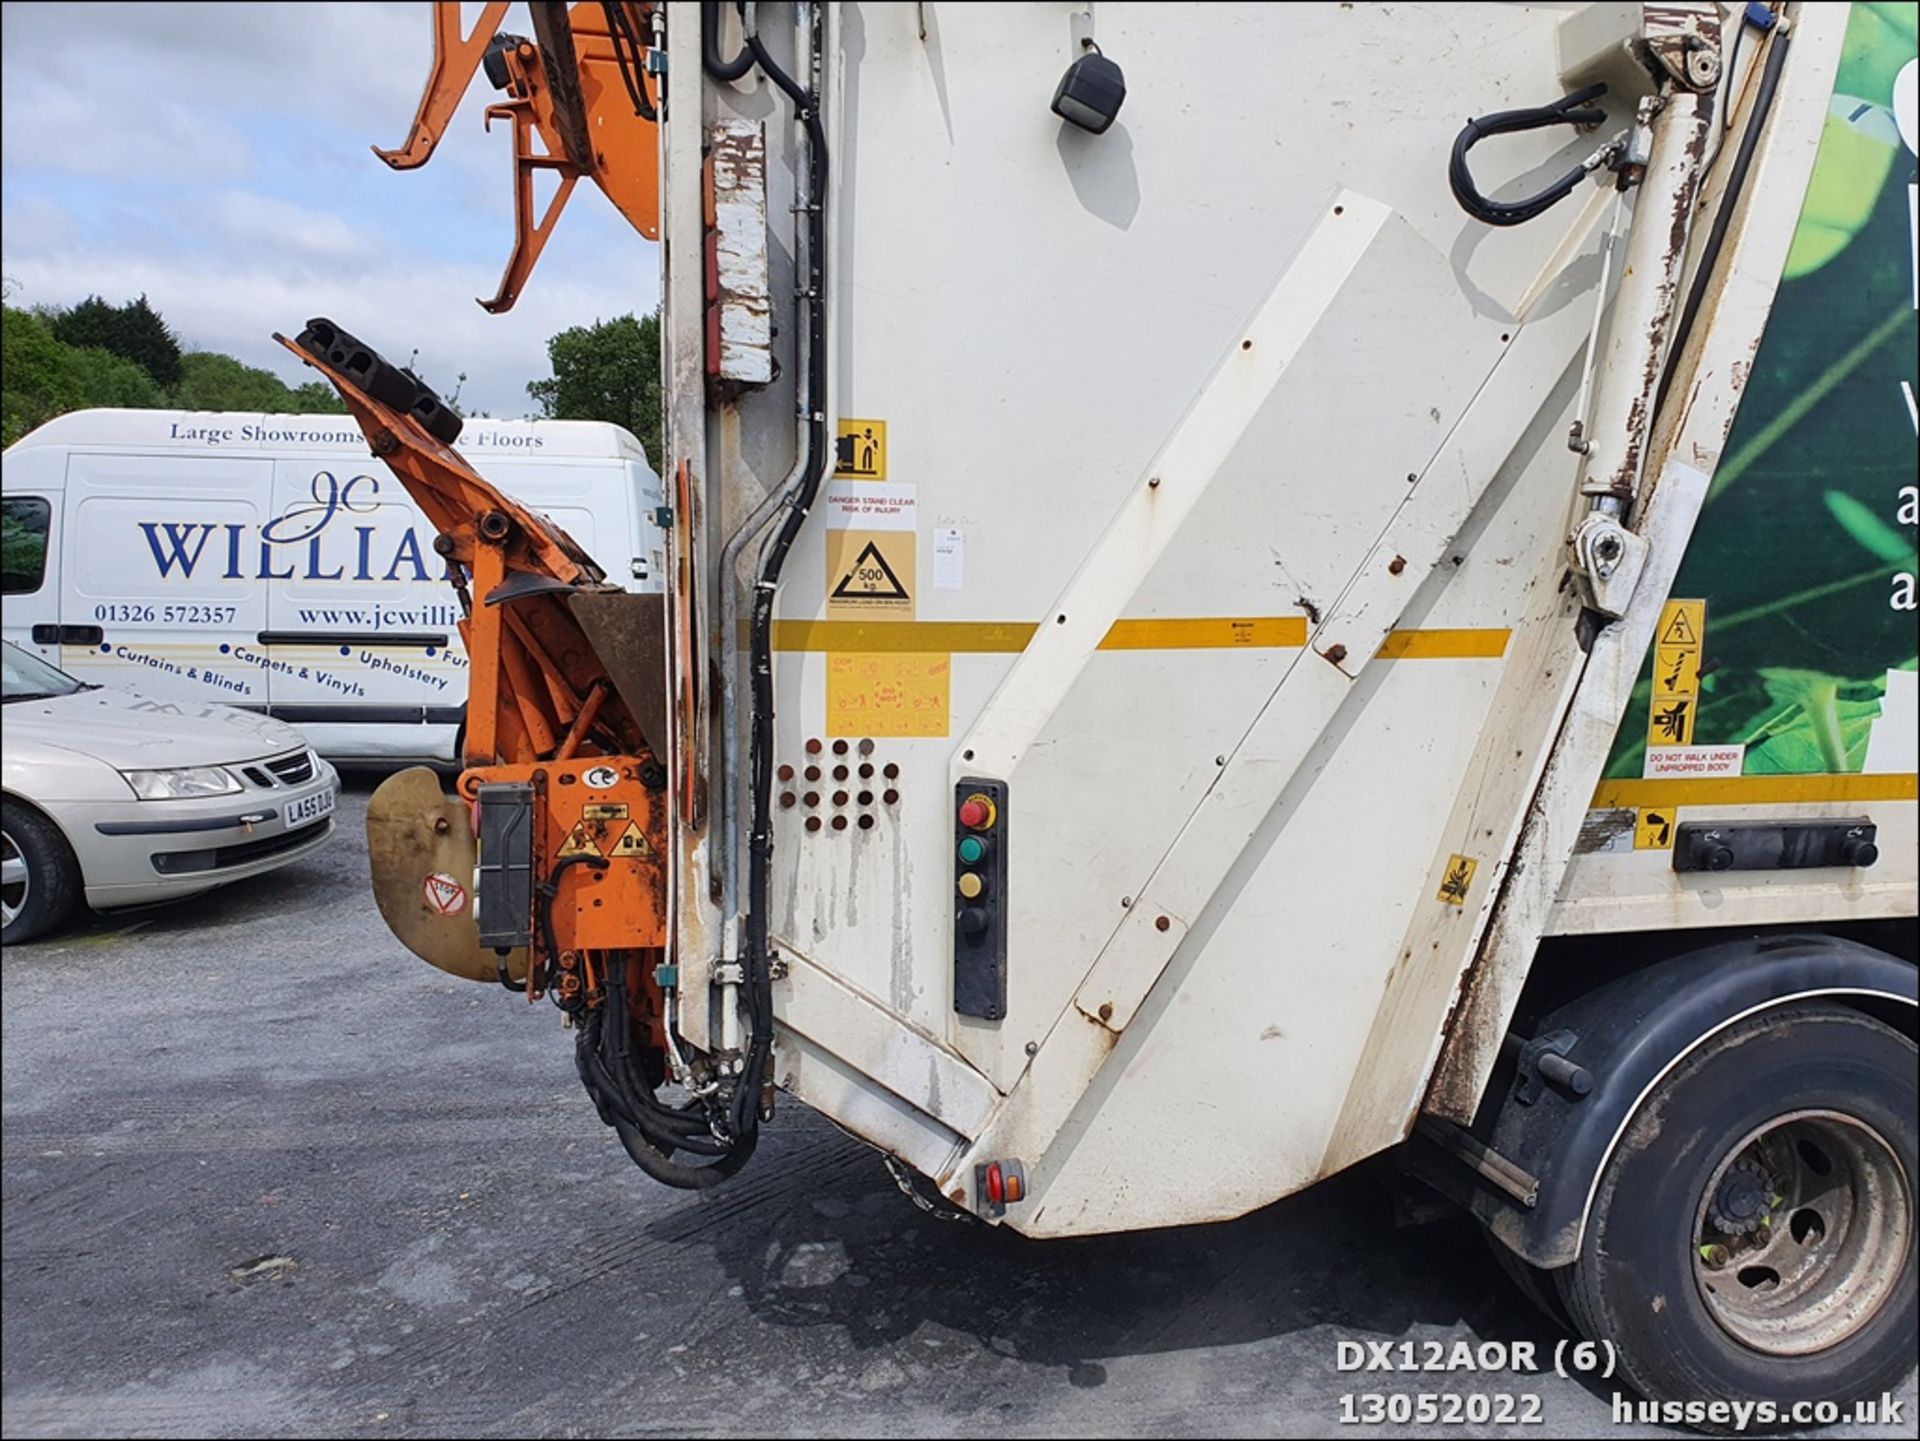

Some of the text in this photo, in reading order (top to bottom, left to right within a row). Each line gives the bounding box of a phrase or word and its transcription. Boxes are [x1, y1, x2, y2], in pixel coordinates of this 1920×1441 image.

[171, 423, 234, 446] Large
[241, 425, 365, 444] Showrooms
[477, 432, 544, 448] Floors
[828, 495, 916, 506] DANGER STAND CLEAR
[841, 505, 902, 514] RISK OF INJURY
[137, 521, 474, 582] WILLIA
[858, 568, 884, 582] 500
[95, 604, 237, 624] 01326 572357
[298, 604, 466, 631] www.jcwilli
[116, 645, 251, 696] Curtains & Blinds
[234, 646, 366, 697] Carpets & Vinyls
[360, 650, 449, 691] Upholstery
[1650, 751, 1739, 762] DO NOT WALK UNDER
[1655, 762, 1731, 772] UNPROPPED BODY
